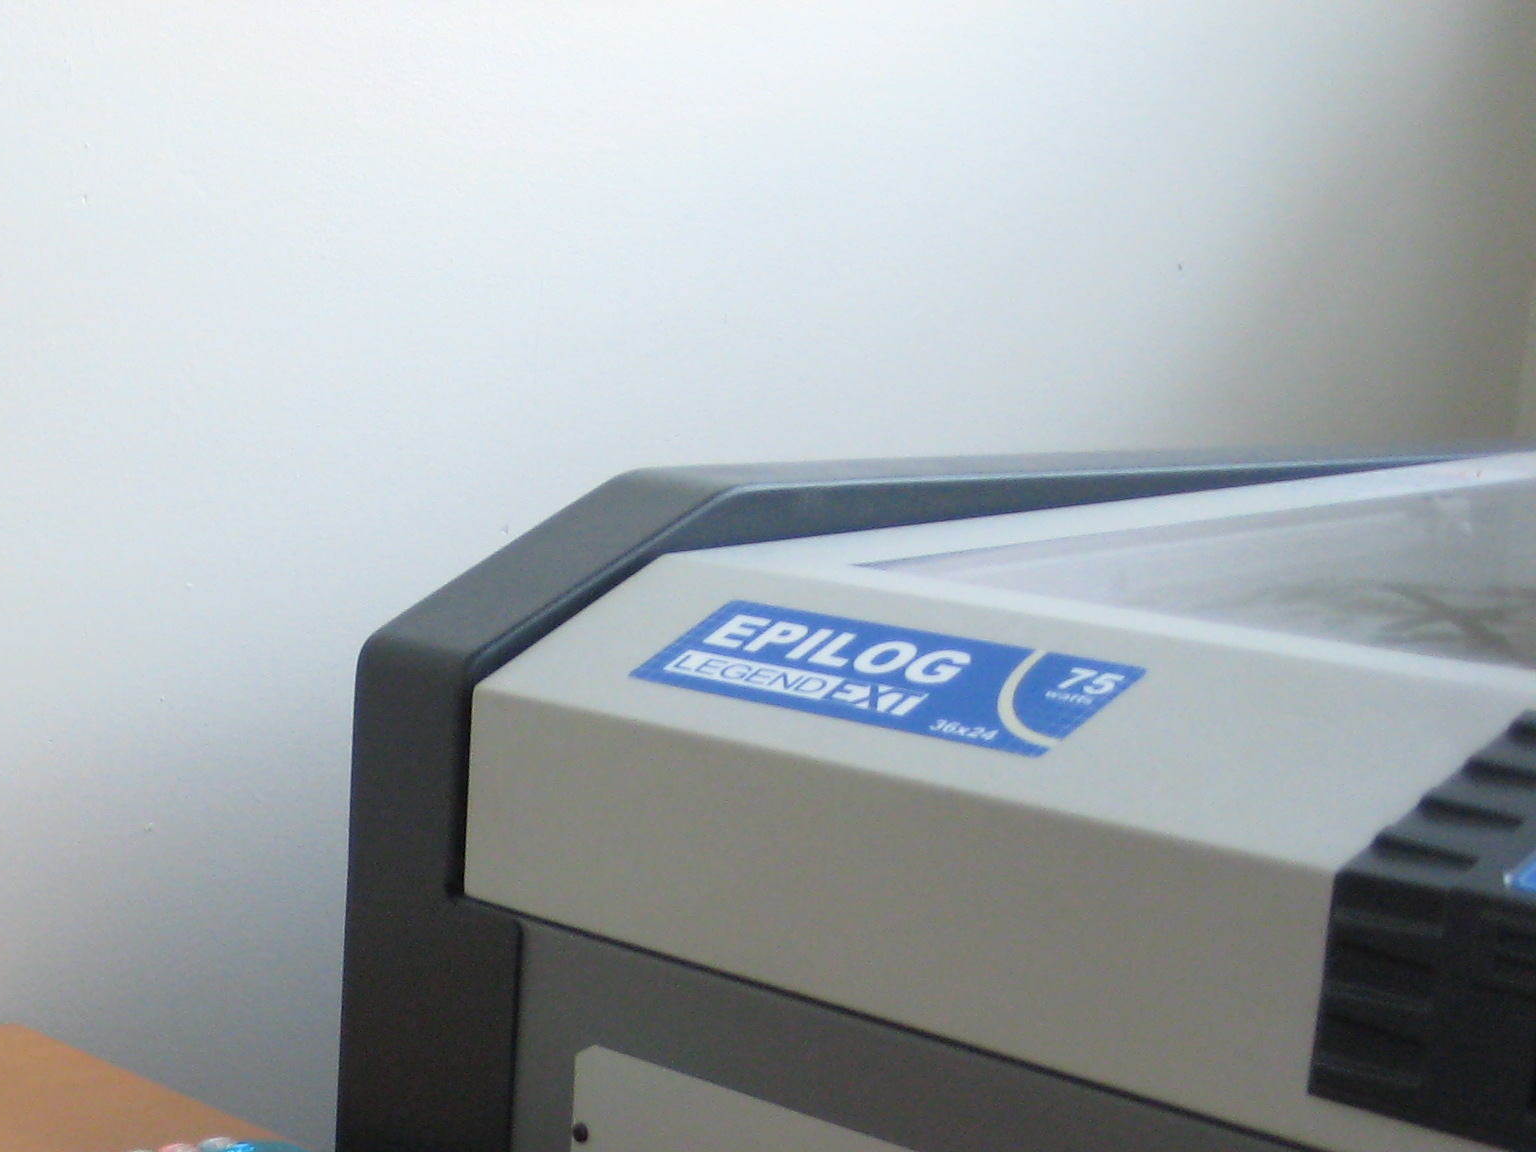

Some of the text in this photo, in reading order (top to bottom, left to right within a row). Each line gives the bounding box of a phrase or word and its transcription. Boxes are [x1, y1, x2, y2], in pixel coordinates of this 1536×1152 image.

[702, 613, 972, 686] EPILOG
[670, 651, 832, 698] LEGEND
[1057, 666, 1126, 696] 75
[928, 717, 1000, 741] 36x24
